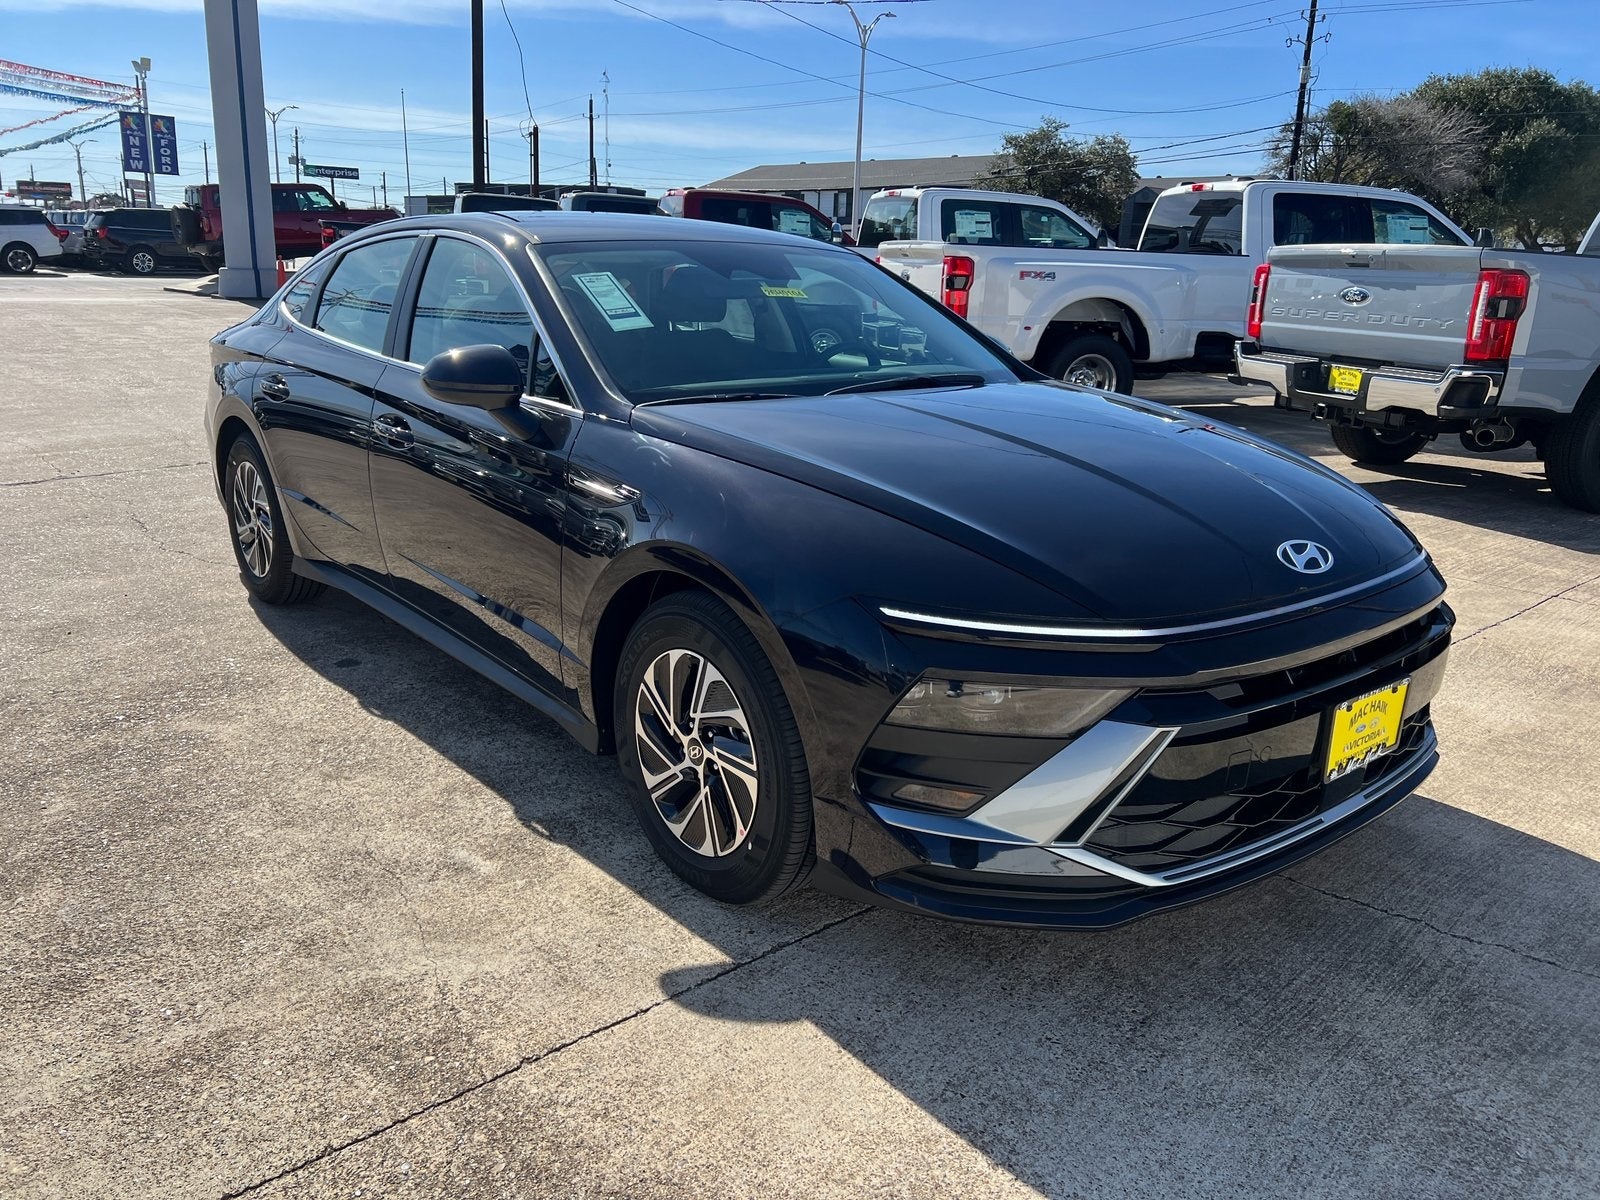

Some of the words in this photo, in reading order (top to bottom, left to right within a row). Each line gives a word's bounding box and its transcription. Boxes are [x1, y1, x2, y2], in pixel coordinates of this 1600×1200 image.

[129, 135, 144, 170] NEW
[159, 139, 172, 173] FORD
[306, 167, 358, 177] enterprise
[1019, 270, 1056, 281] FX4
[1271, 306, 1360, 323] SUPER
[1367, 313, 1456, 329] DUTY
[1348, 701, 1370, 730] MAC
[1348, 728, 1381, 751] VICTORIA
